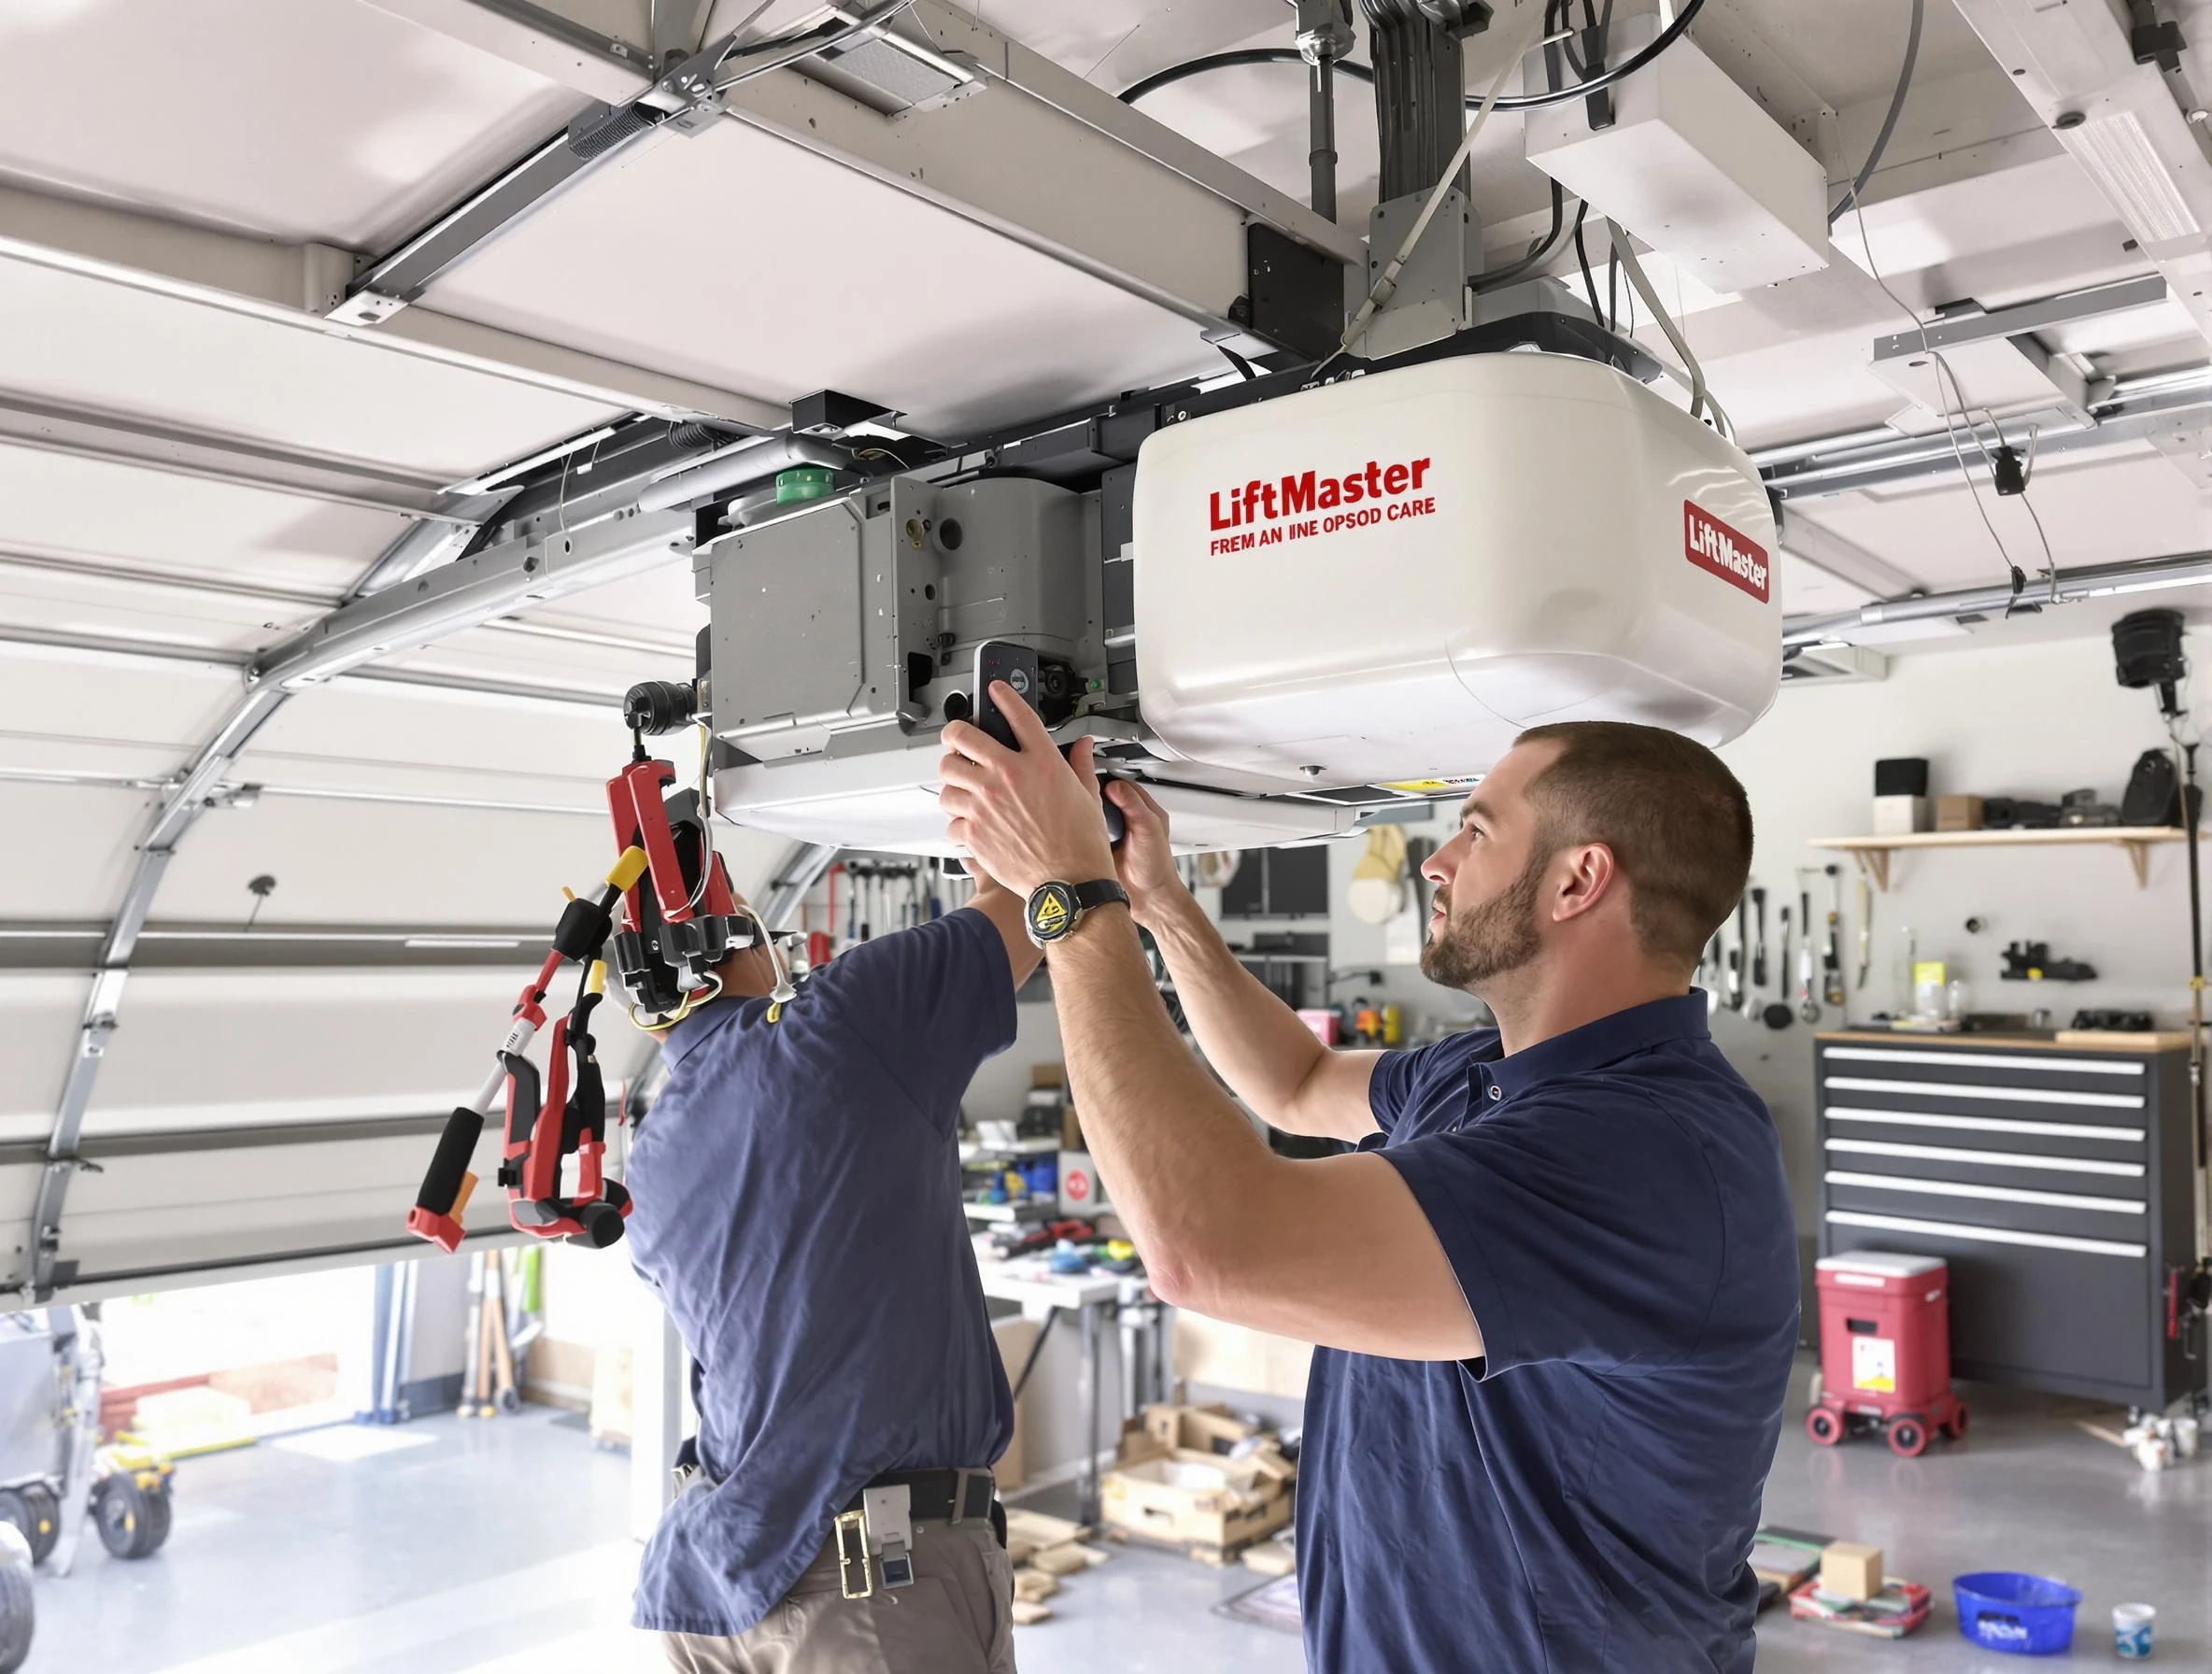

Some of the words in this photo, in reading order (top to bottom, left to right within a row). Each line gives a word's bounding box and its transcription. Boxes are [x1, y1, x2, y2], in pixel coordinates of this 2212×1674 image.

[1210, 458, 1430, 532] LiftMaster
[1211, 532, 1255, 557] FREM
[1259, 527, 1283, 547] AN
[1323, 507, 1382, 533] OPSOD
[1387, 497, 1436, 522] CARE
[1689, 514, 1766, 590] LiftMaster
